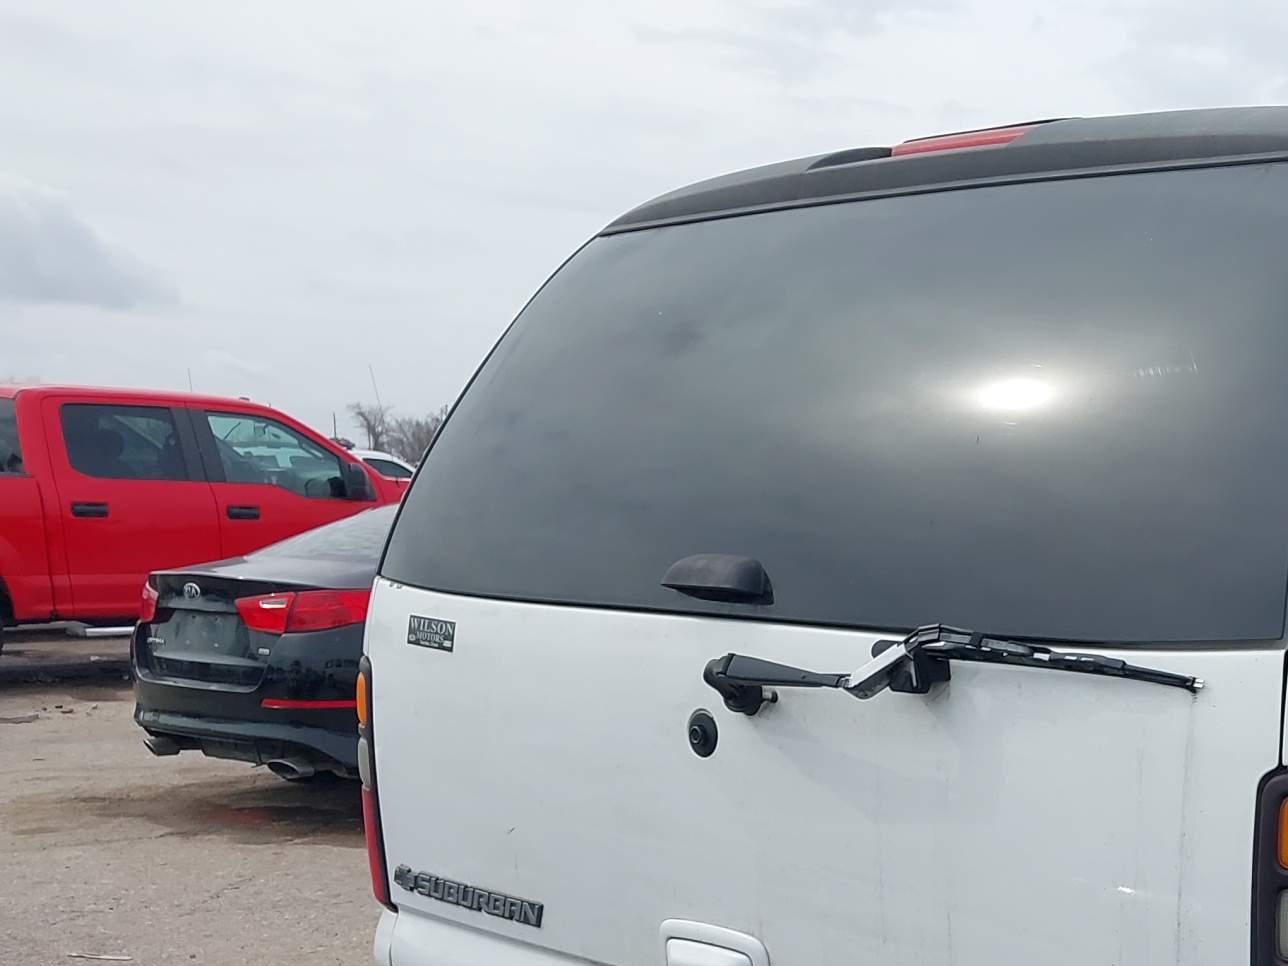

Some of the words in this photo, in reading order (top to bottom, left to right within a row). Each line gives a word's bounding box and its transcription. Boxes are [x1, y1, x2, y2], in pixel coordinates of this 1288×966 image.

[410, 617, 455, 635] WILSON
[416, 631, 445, 643] MOTORS
[415, 871, 544, 928] SUBURBAN
